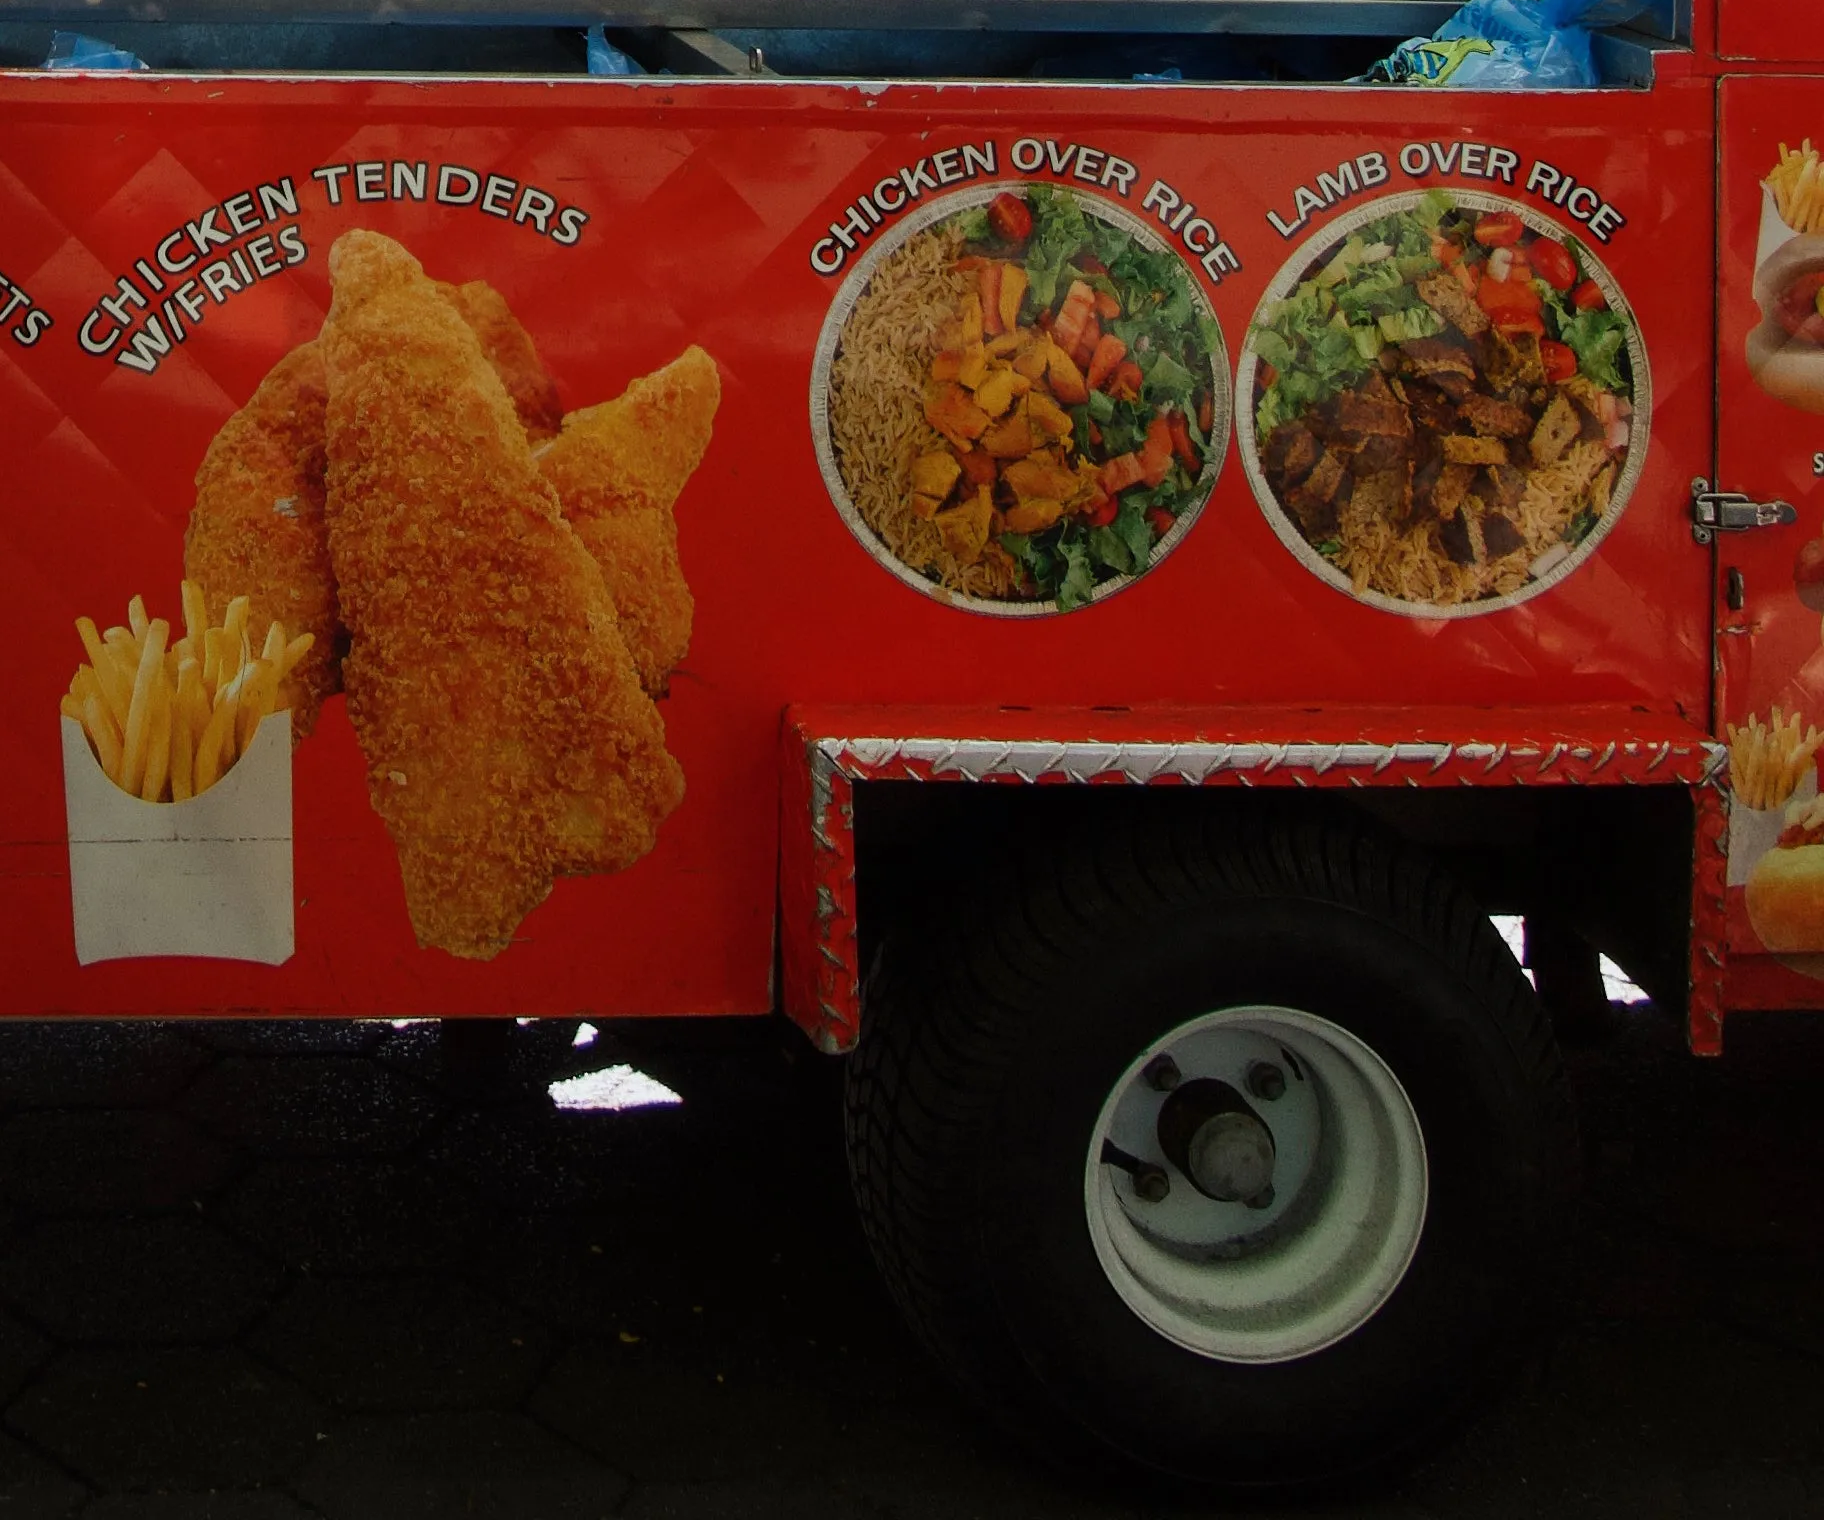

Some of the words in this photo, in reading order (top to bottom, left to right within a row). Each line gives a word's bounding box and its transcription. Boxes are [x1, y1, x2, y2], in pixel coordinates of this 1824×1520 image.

[77, 176, 300, 357] CHICKEN
[312, 160, 591, 247] TENDERS
[807, 142, 999, 279] CHICKEN
[1010, 137, 1136, 196] OVER
[1139, 181, 1243, 286] RICE
[1265, 154, 1388, 240] LAMB
[1396, 142, 1522, 183] OVER
[1522, 162, 1629, 247] RICE
[115, 224, 311, 377] W/FRIES
